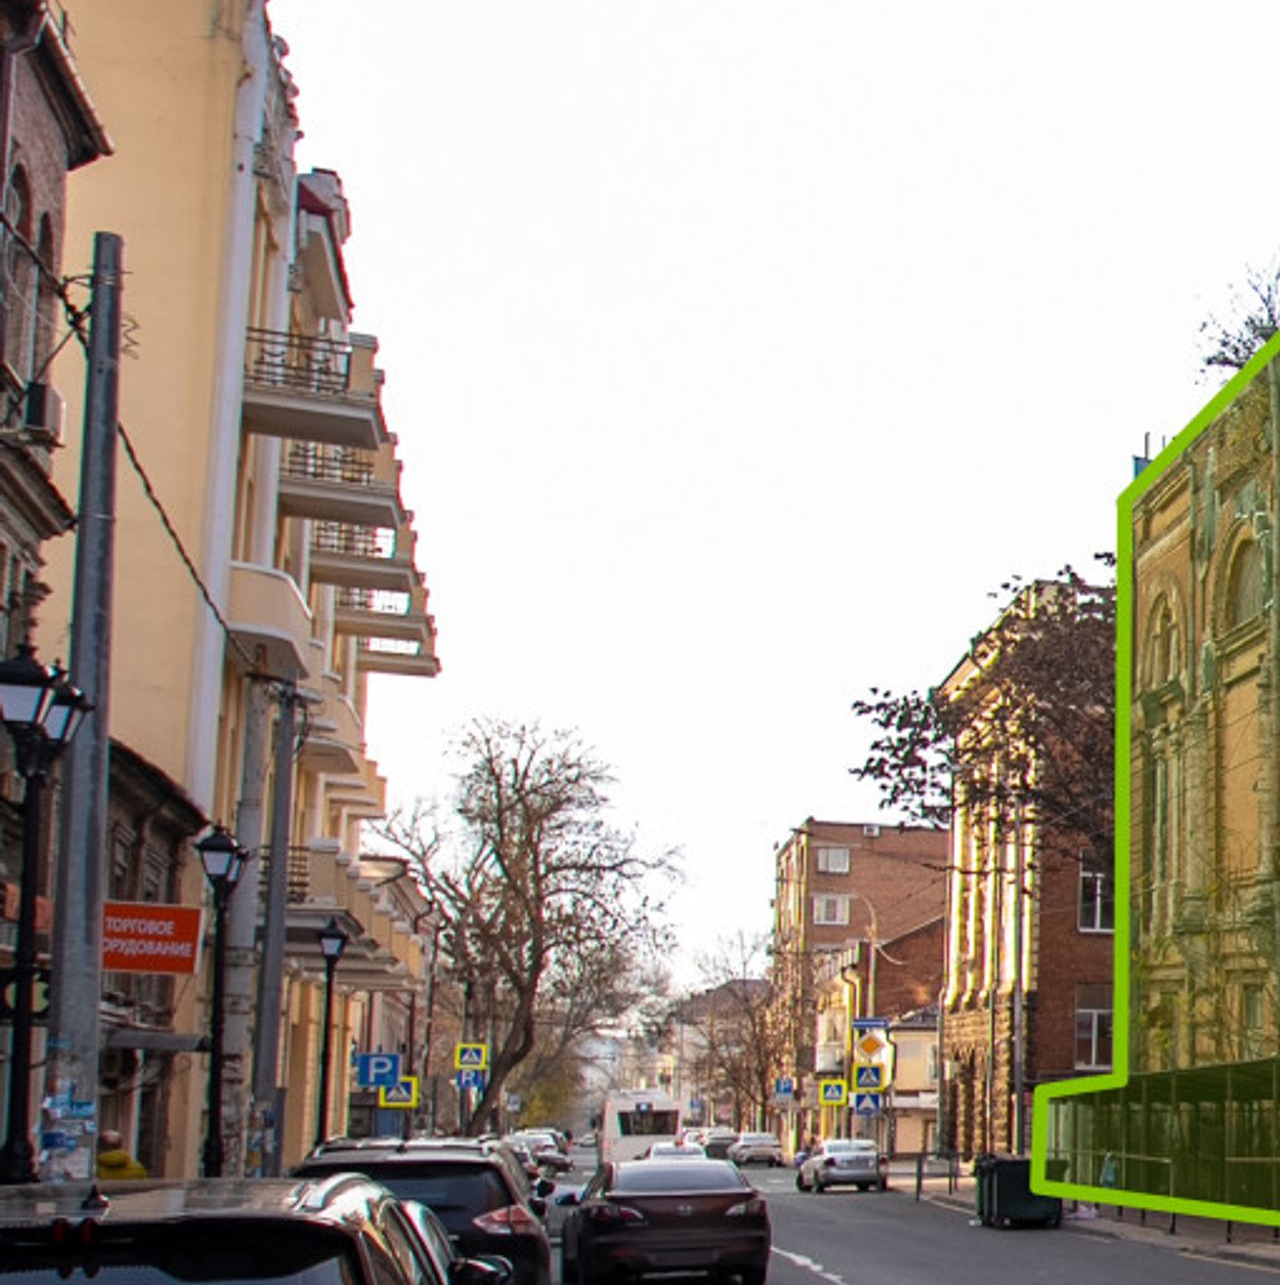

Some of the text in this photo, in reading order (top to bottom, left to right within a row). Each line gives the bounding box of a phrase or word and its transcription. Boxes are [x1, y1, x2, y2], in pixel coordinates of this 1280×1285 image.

[105, 917, 175, 935] ТОРГОВОЕ
[102, 938, 192, 957] ОРУДОВАНИЕ
[368, 1056, 393, 1083] P
